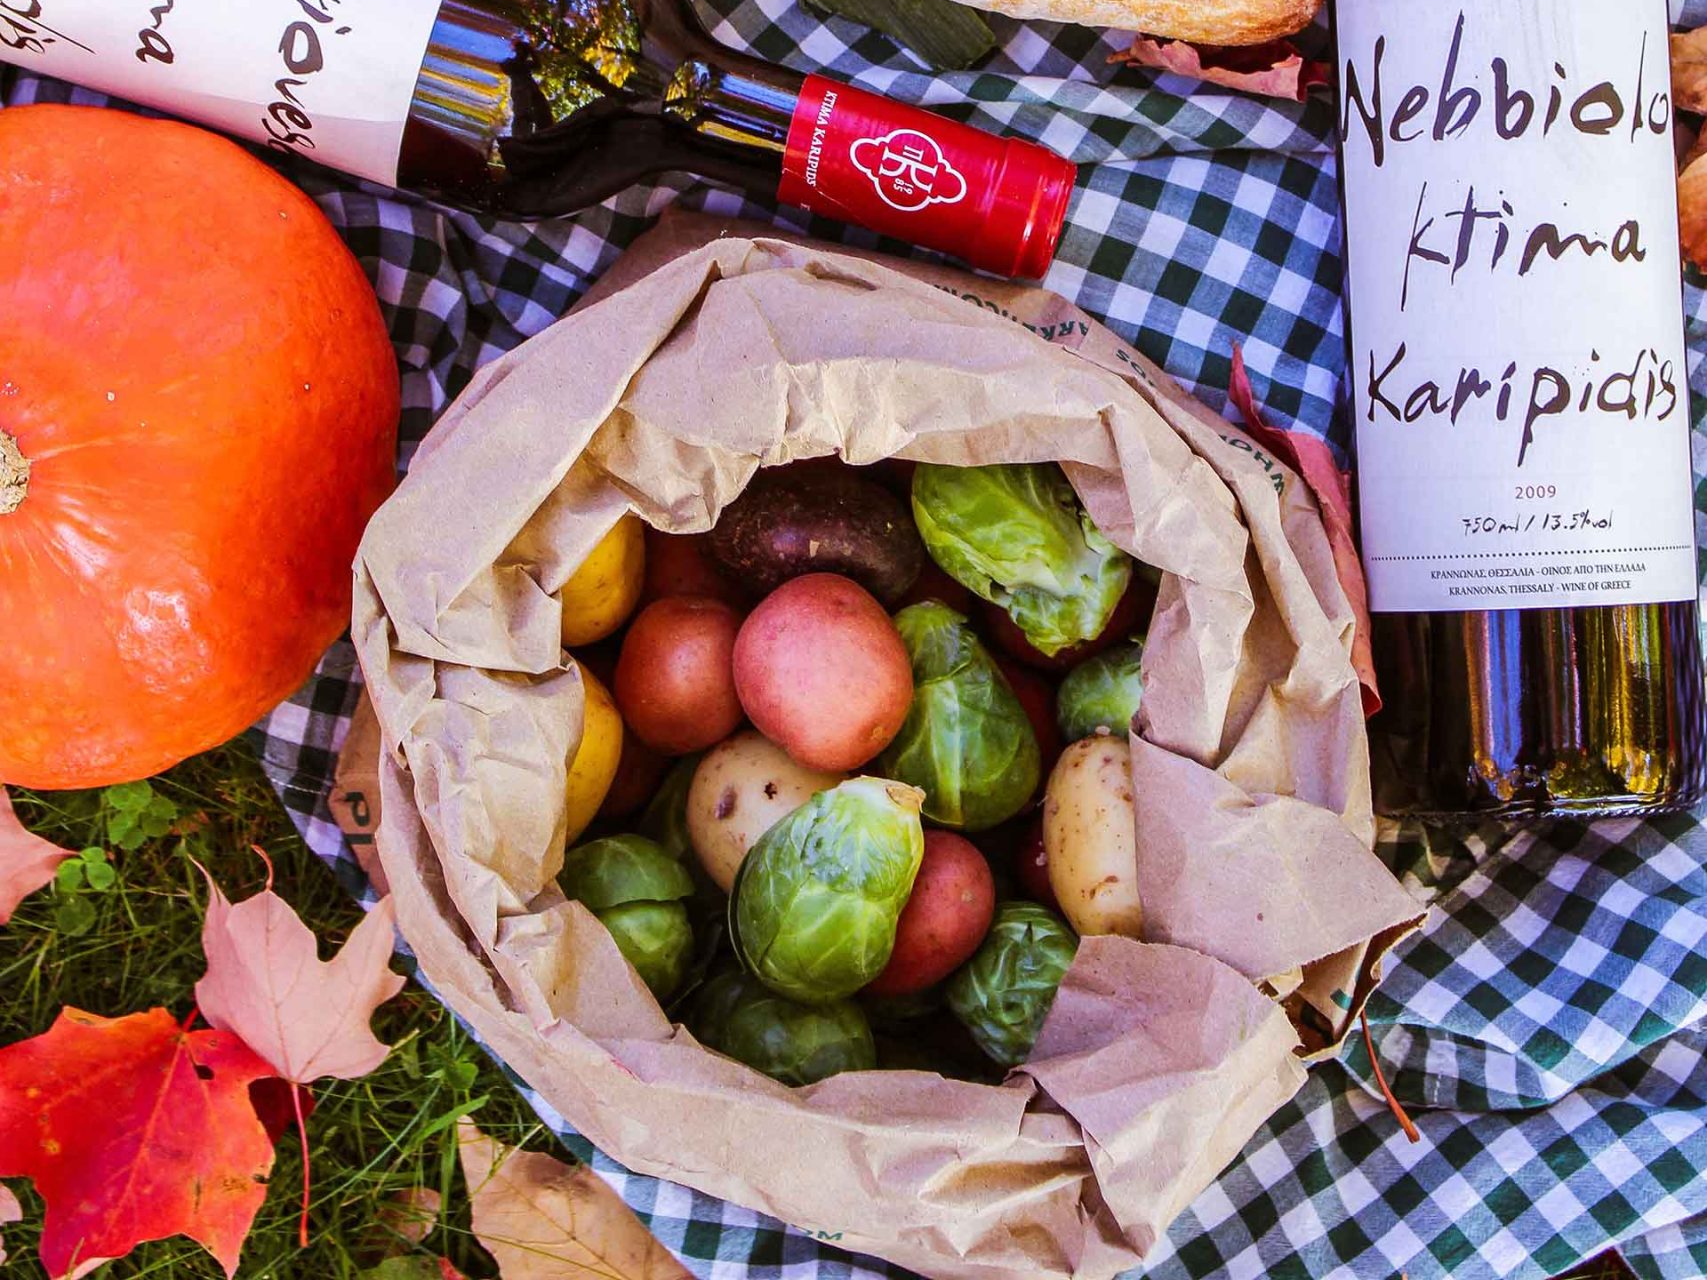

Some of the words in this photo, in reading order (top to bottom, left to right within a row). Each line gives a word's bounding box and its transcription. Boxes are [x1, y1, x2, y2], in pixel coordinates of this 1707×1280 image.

[1341, 9, 1669, 167] Nebbiolo
[816, 90, 838, 125] KTIMA
[1368, 342, 1677, 467] Karipidis
[1515, 485, 1556, 499] 2009
[1508, 583, 1554, 594] THESSALY
[1561, 582, 1587, 592] WINE
[1587, 581, 1599, 591] OF
[1600, 579, 1632, 590] GREECE
